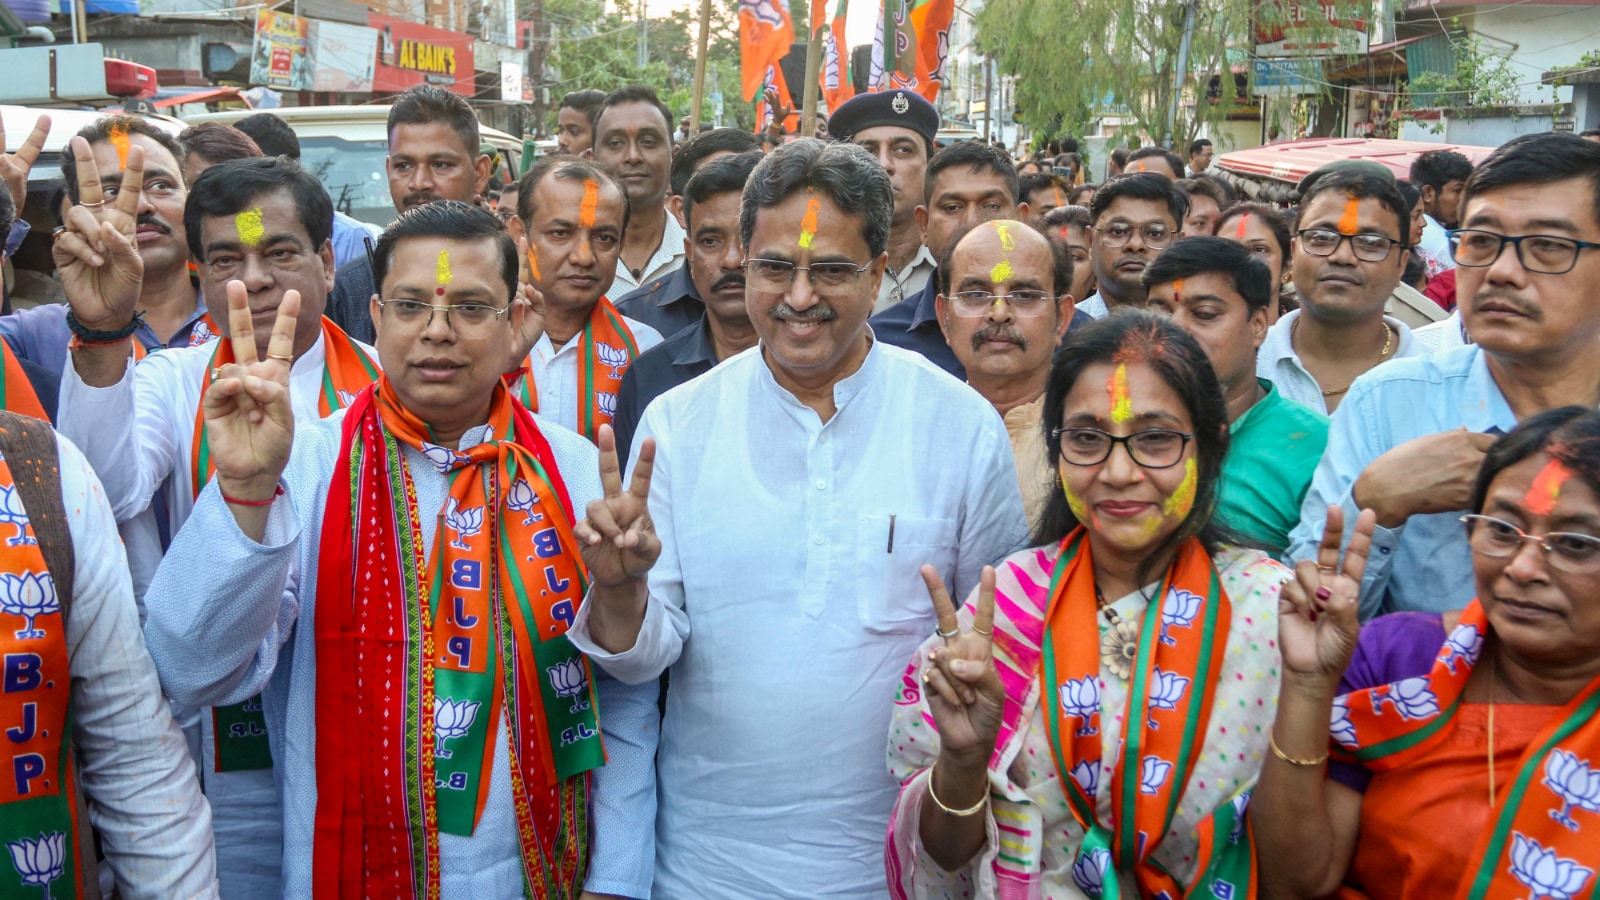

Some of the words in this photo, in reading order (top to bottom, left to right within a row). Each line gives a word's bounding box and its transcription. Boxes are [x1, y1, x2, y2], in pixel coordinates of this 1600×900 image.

[399, 39, 417, 69] AL
[417, 42, 456, 74] BAIK'S
[1256, 62, 1268, 71] Dr.
